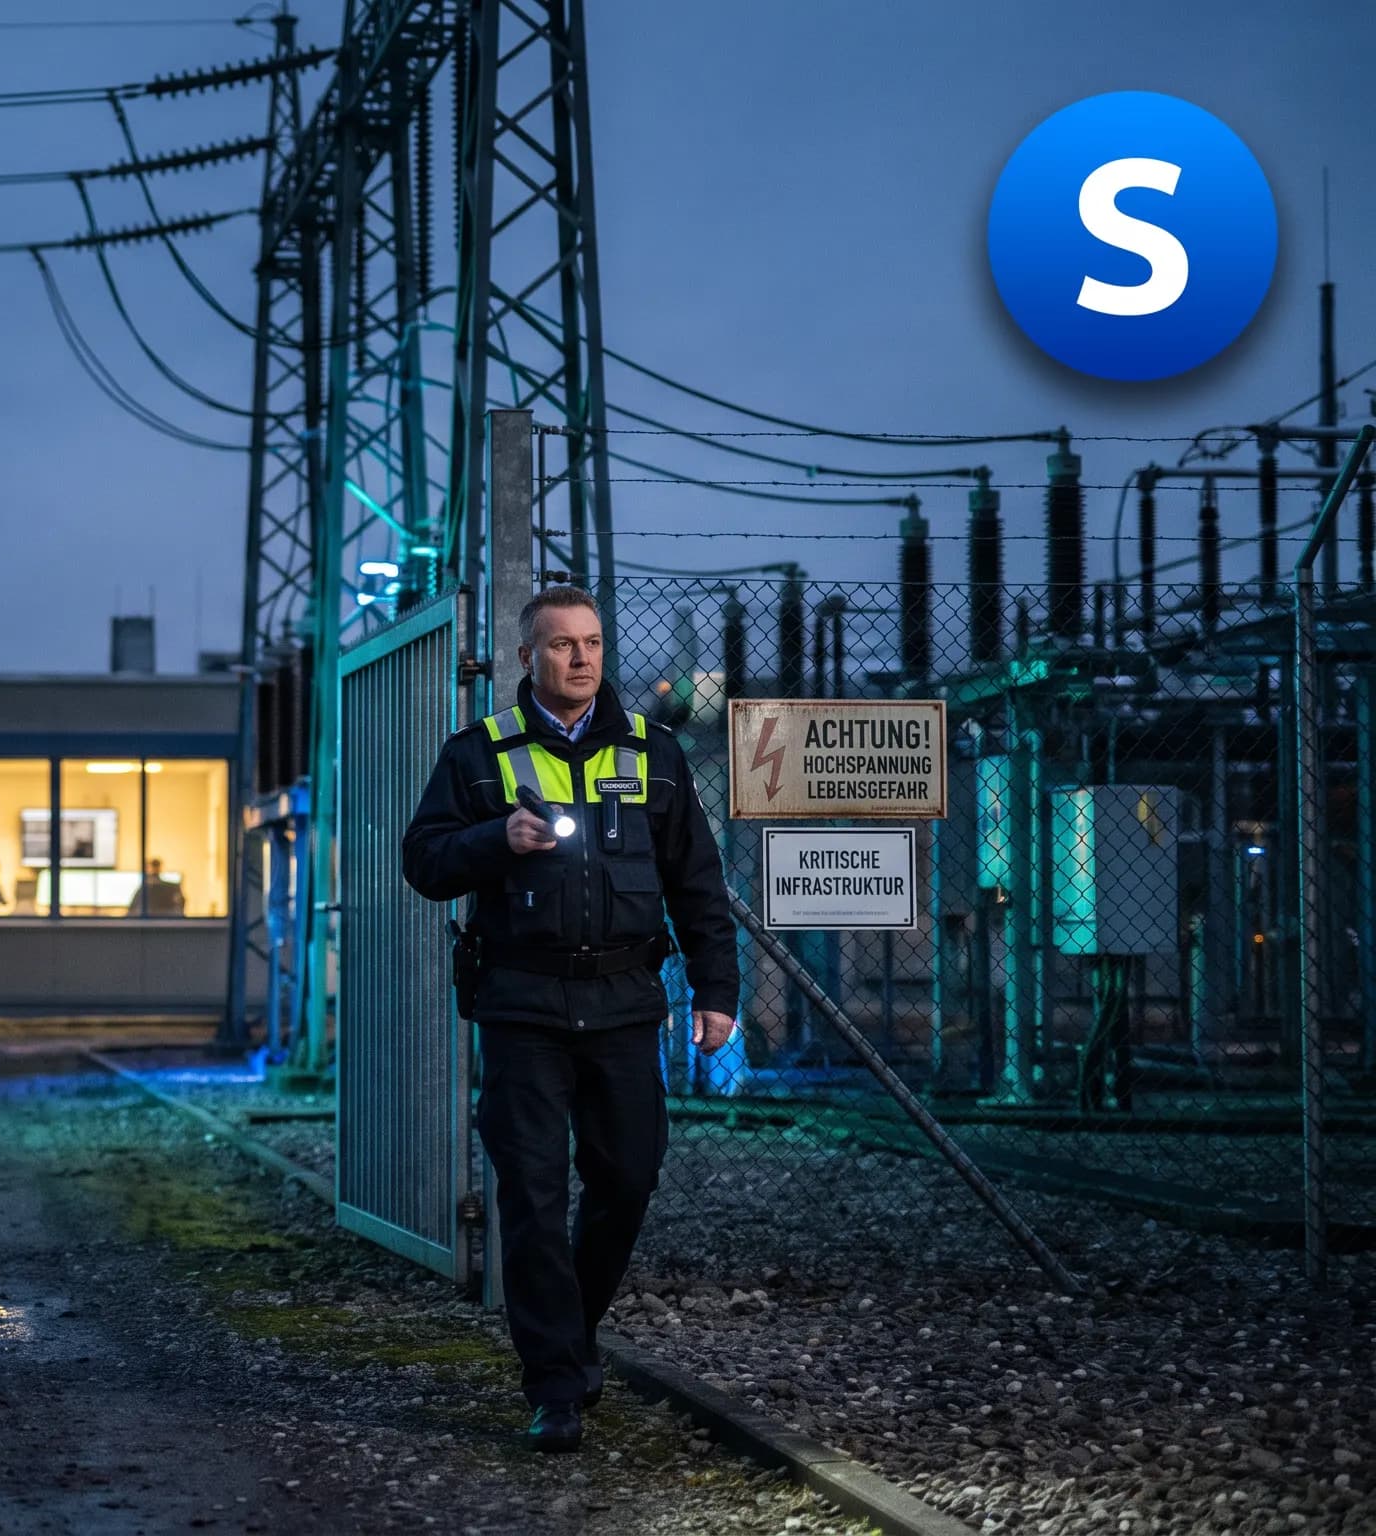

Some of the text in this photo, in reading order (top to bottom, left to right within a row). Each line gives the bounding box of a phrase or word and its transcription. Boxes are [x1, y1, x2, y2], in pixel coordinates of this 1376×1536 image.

[804, 719, 930, 749] ACHTUNG!
[803, 755, 932, 775] HOCHSPANNUNG
[807, 780, 929, 800] LEBENSGEFAHR
[799, 850, 881, 869] KRITISCHE
[775, 876, 905, 896] INFRASTRUKTUR
